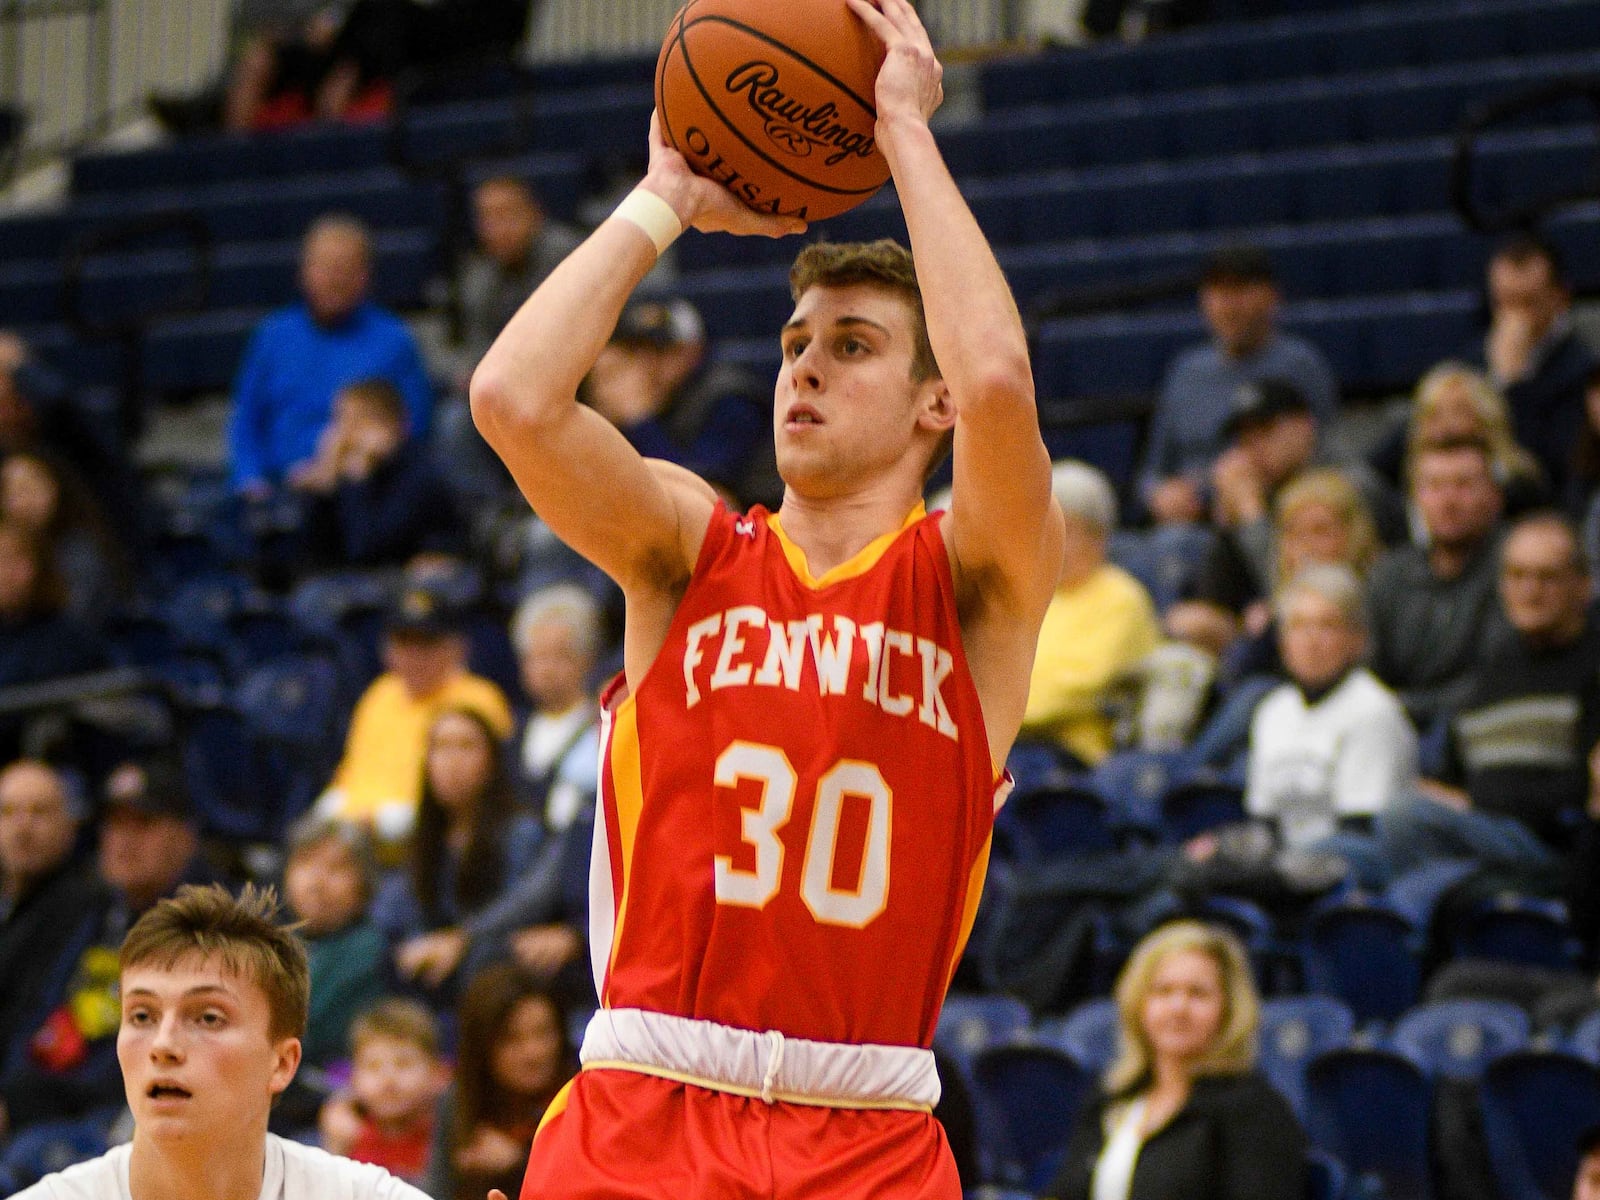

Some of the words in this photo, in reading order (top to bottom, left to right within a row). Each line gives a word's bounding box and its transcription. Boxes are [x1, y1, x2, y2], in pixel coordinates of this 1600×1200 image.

[725, 60, 875, 167] Rawlings
[683, 605, 959, 743] FENWICK
[713, 739, 893, 930] 30
